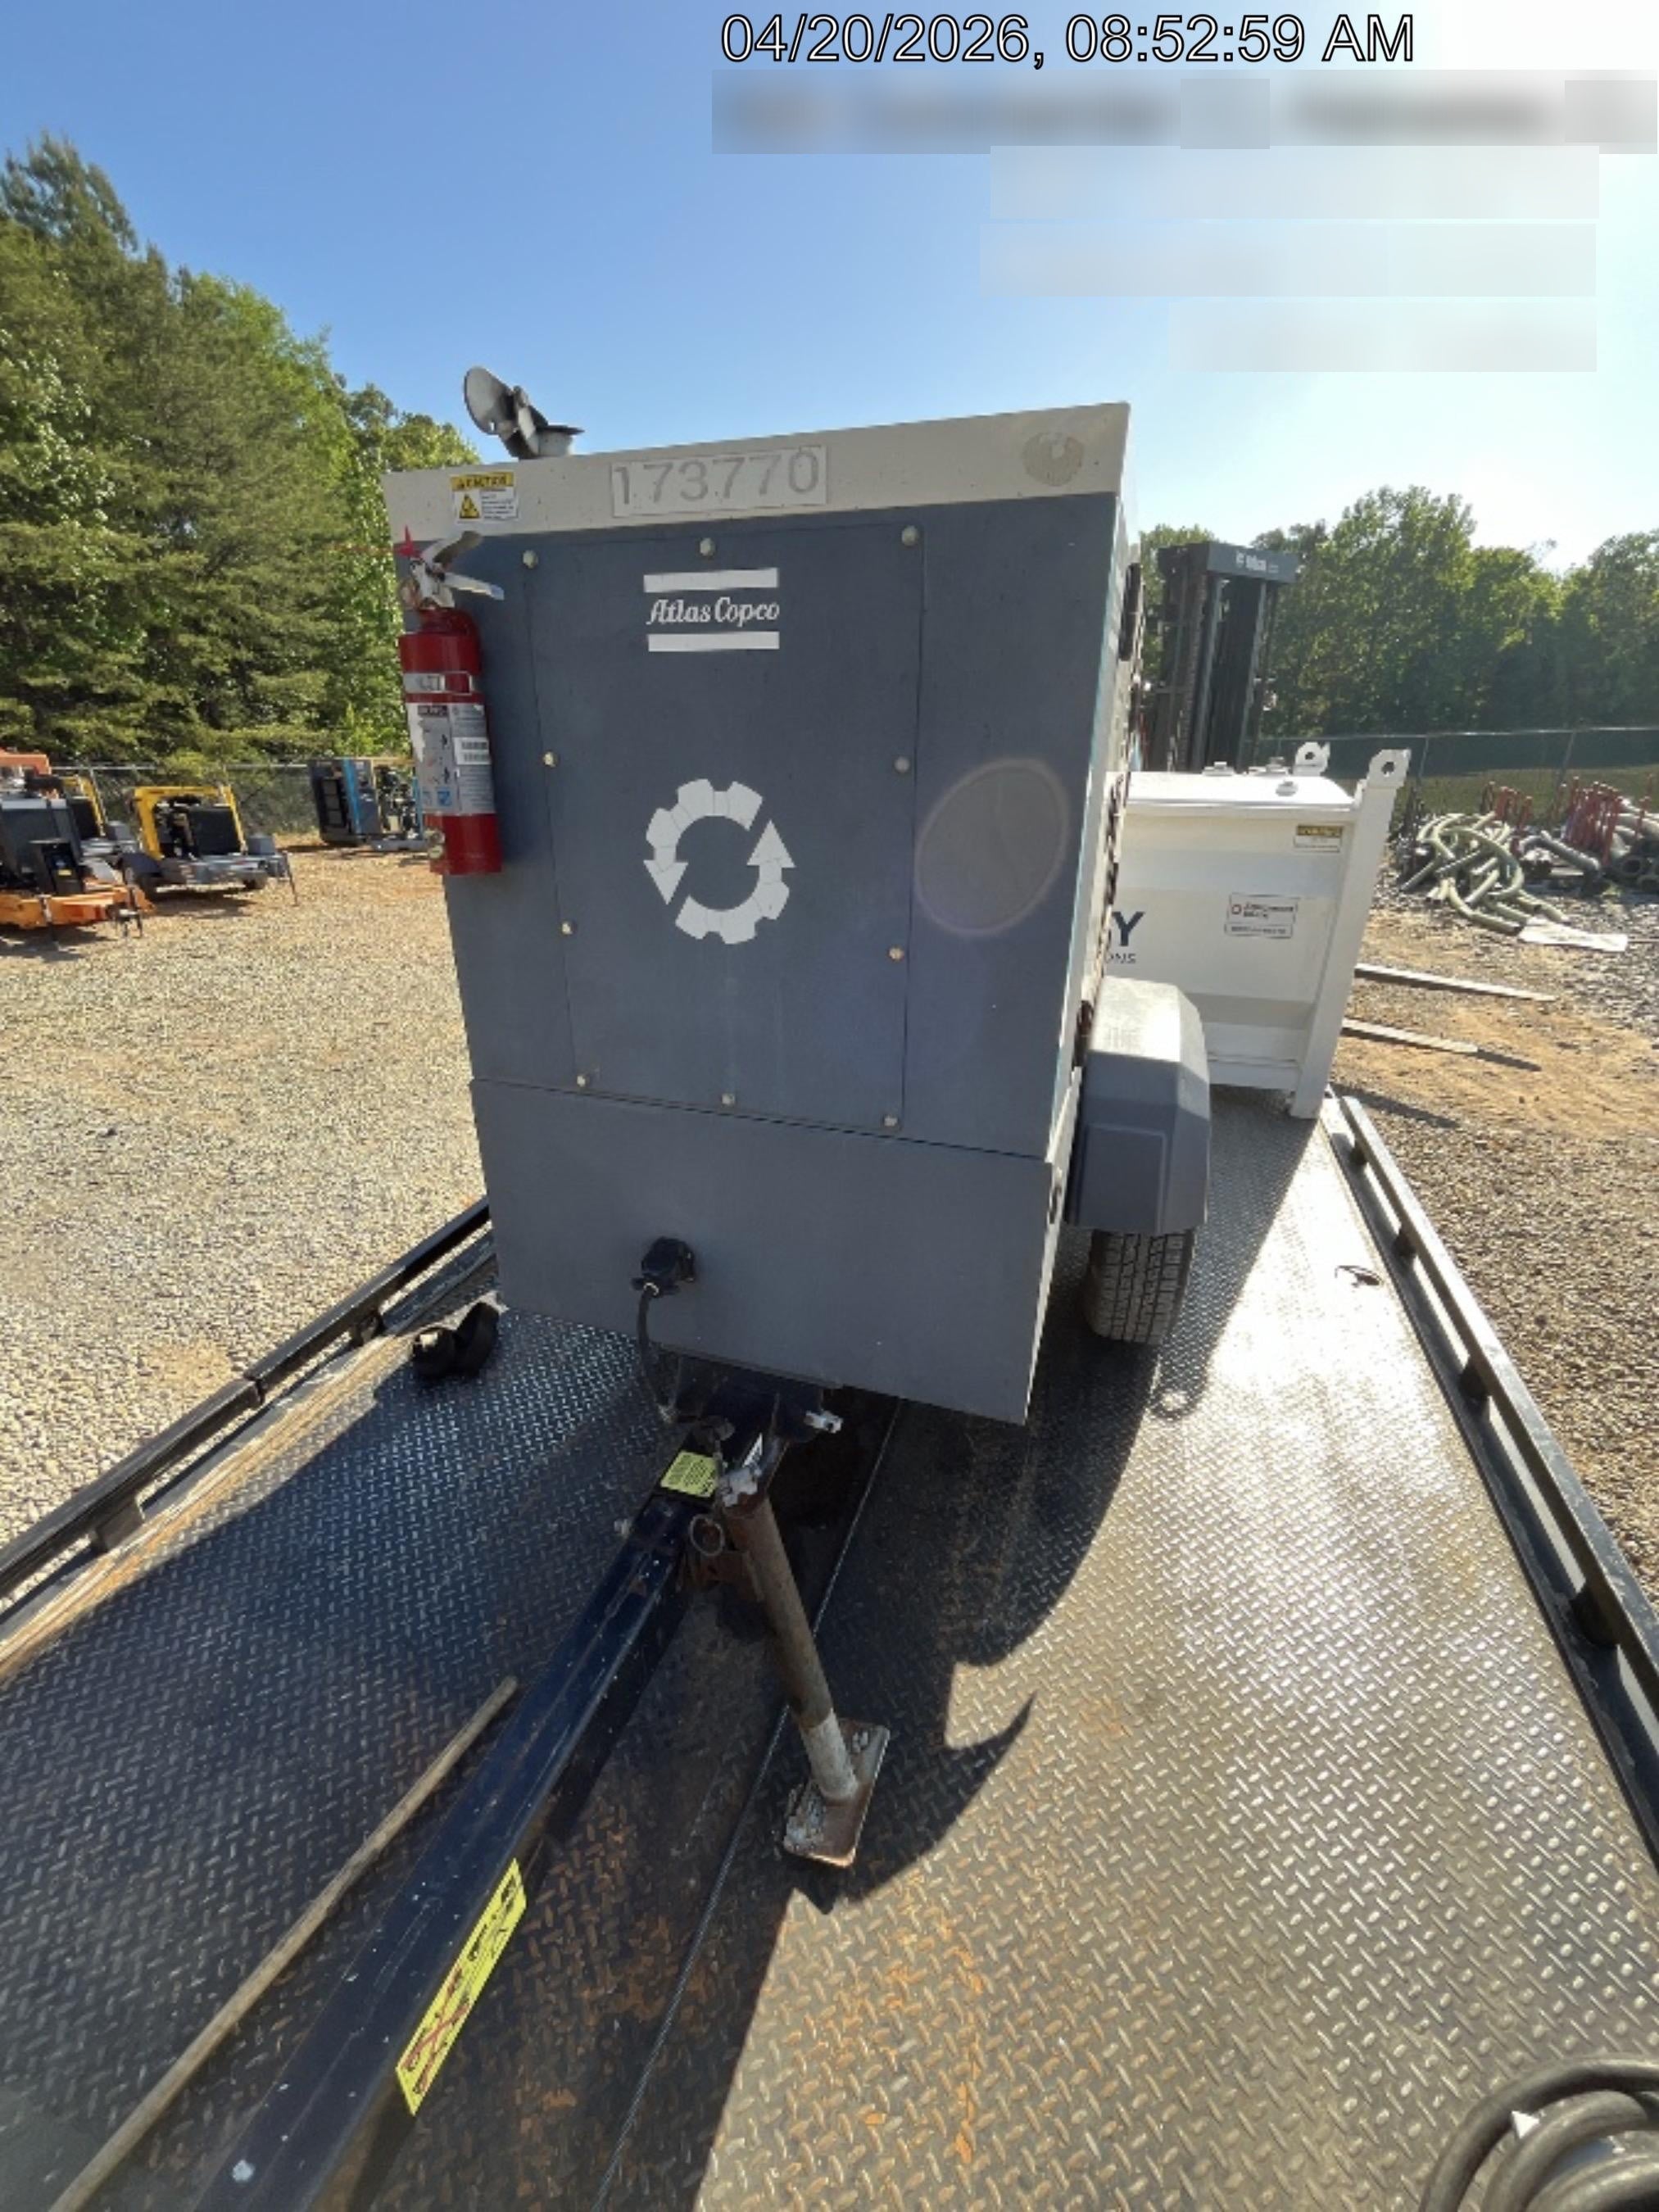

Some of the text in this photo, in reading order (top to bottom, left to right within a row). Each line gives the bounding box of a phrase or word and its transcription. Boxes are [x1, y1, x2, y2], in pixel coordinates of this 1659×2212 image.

[614, 451, 819, 504] 173770
[646, 596, 780, 628] Atlas Copco
